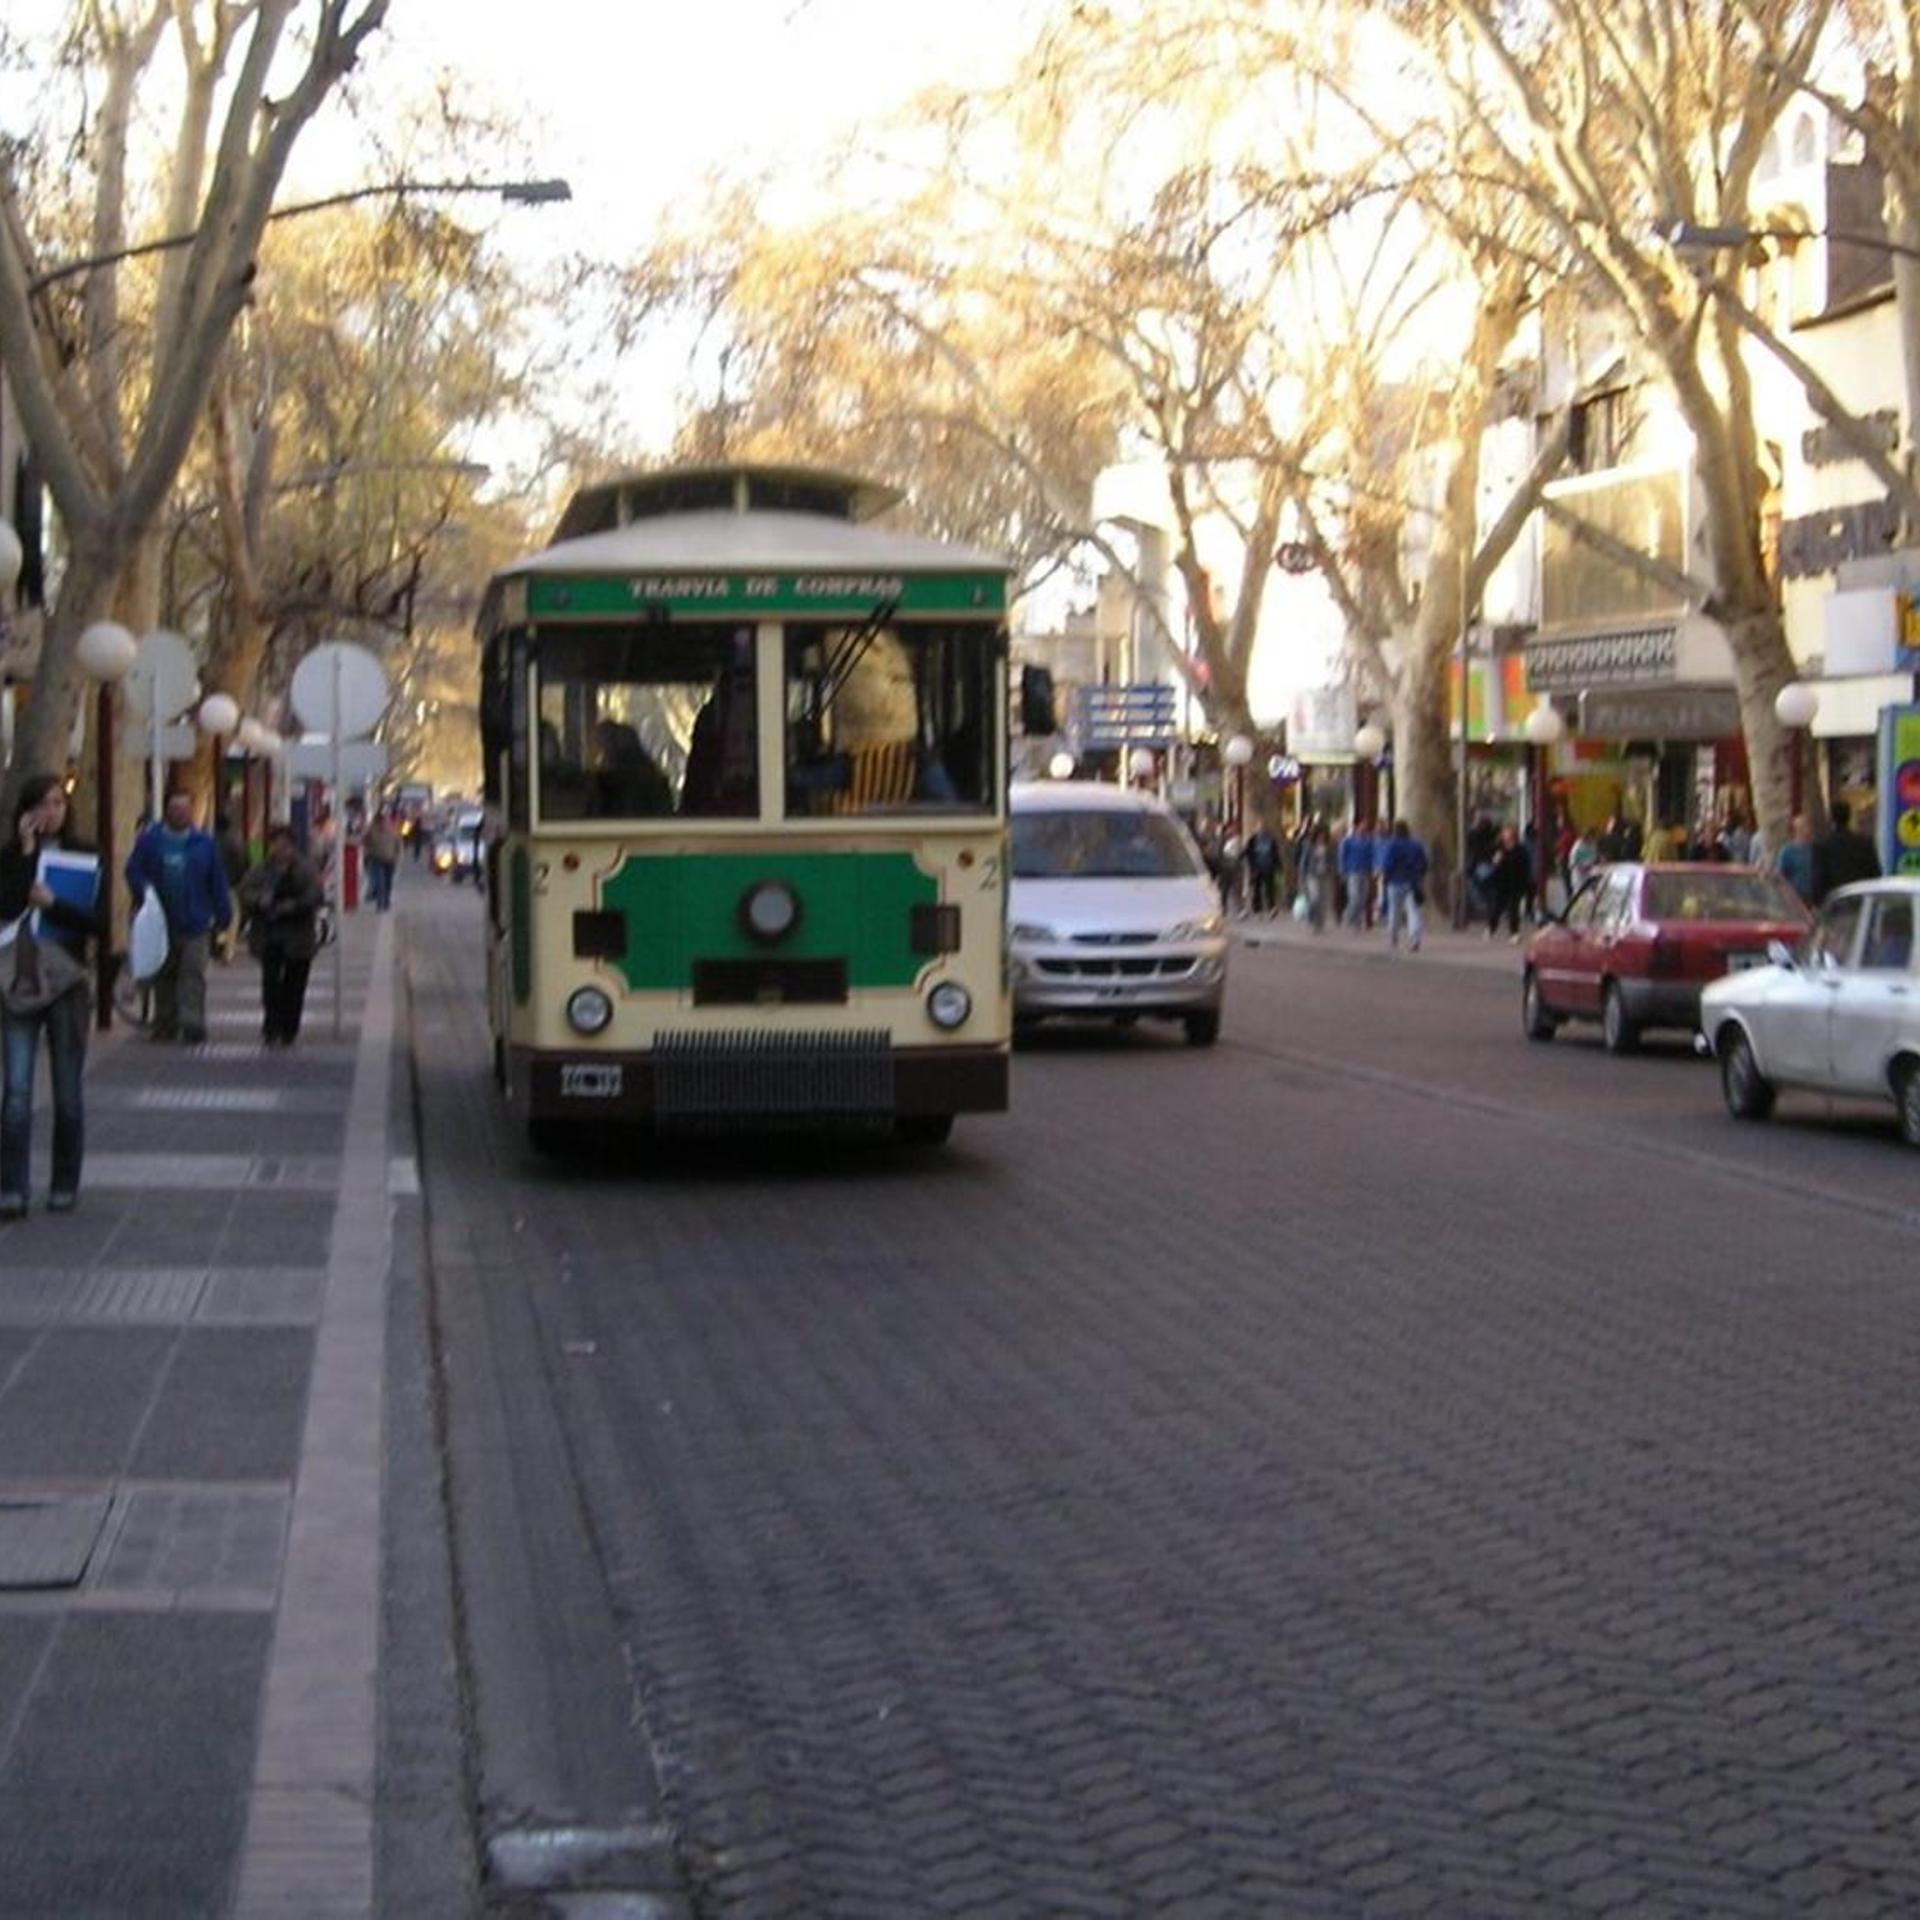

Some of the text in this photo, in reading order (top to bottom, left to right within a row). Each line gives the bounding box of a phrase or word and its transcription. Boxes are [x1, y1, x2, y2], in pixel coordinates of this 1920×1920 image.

[744, 577, 778, 597] DE
[533, 861, 550, 896] 2
[979, 856, 999, 891] 2
